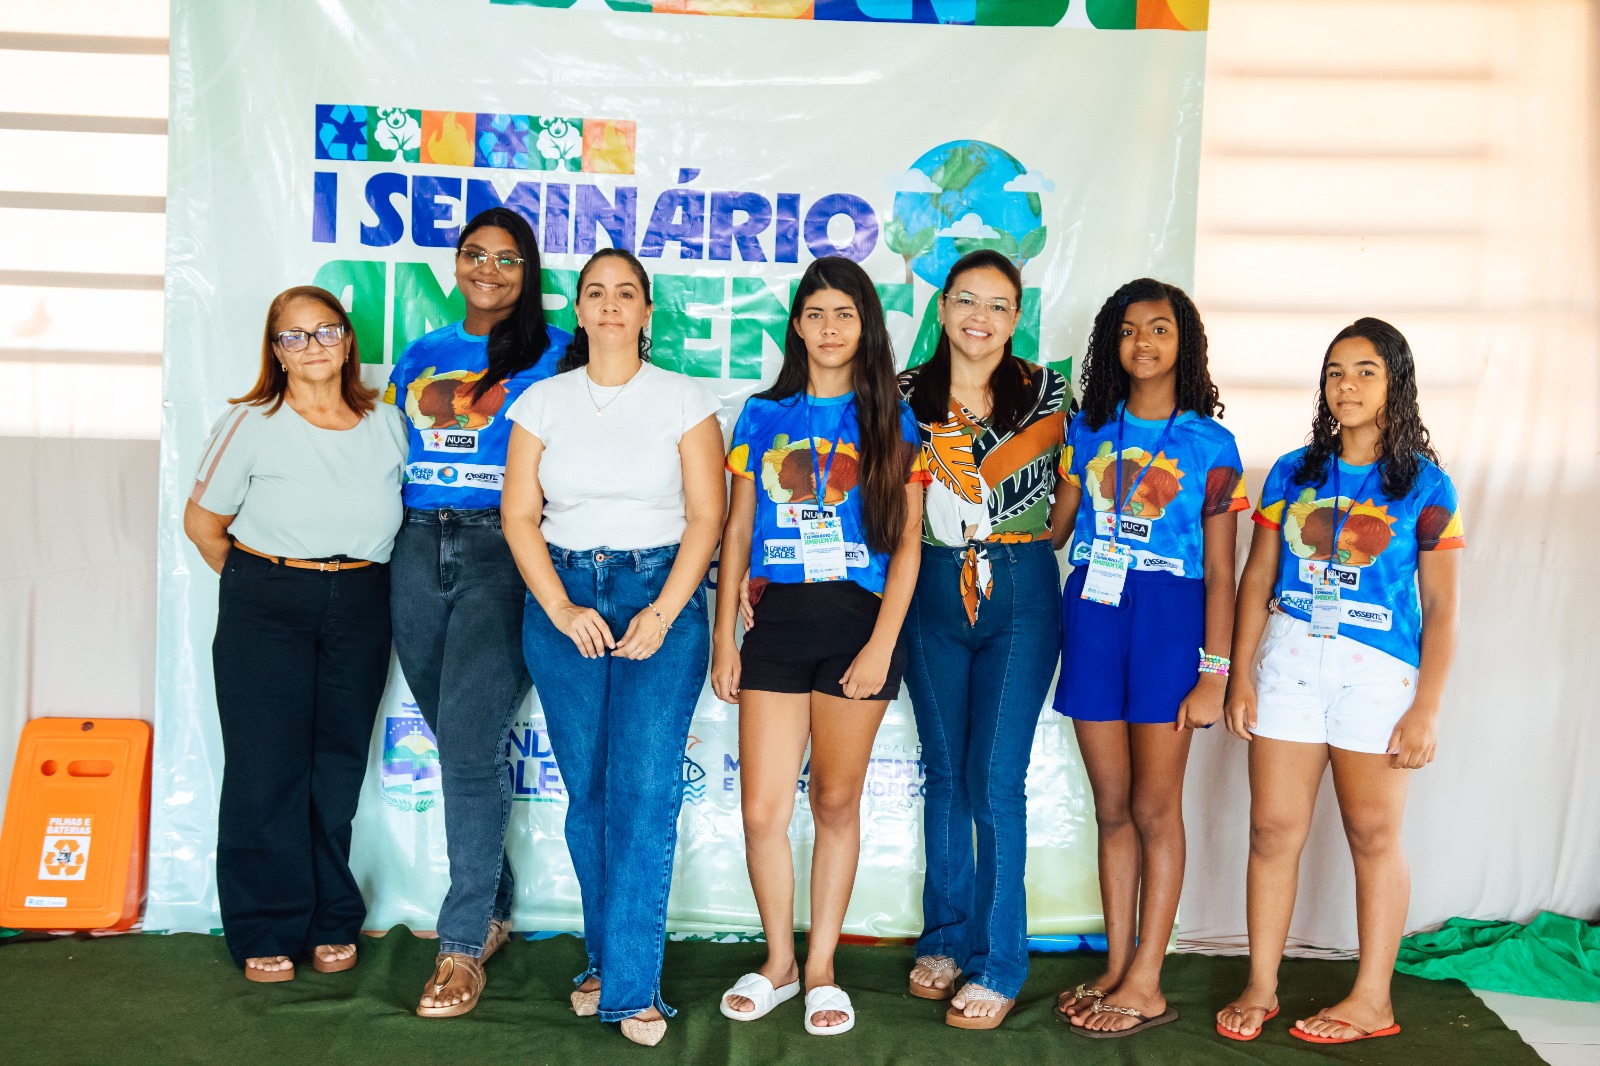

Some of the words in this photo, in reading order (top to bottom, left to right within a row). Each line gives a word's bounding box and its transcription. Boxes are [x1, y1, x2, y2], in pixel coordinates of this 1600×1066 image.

[312, 172, 337, 243] I
[360, 168, 878, 264] SEMINÁRIO
[447, 436, 472, 444] NUCA
[803, 511, 831, 519] NUA
[769, 551, 796, 559] SALES
[1348, 609, 1383, 621] ASSERTE
[49, 817, 82, 826] PILHAS
[84, 817, 91, 826] E
[46, 825, 91, 835] BATERIAS
